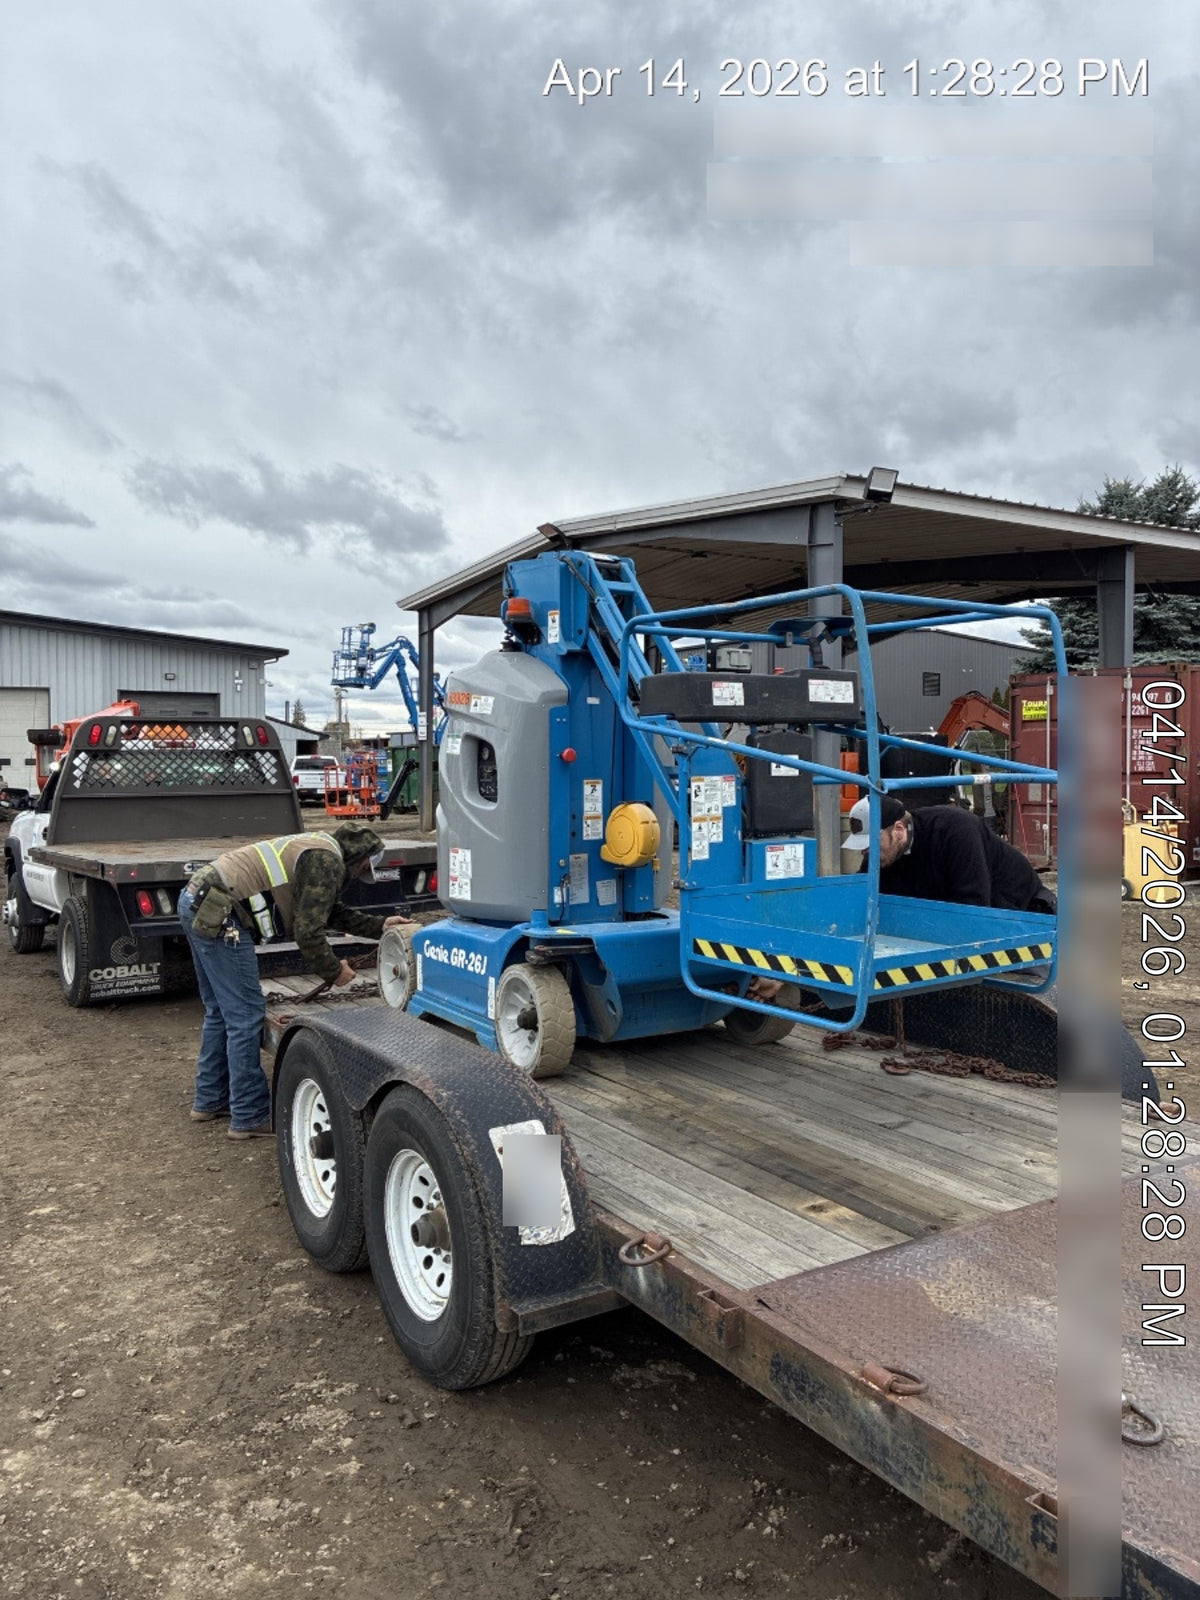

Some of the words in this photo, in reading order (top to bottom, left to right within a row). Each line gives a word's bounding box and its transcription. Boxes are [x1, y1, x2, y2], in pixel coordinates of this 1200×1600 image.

[424, 940, 449, 964] Genie
[451, 948, 487, 975] GR-26J
[89, 962, 161, 981] COBALT
[90, 985, 160, 998] cobalttruck.com
